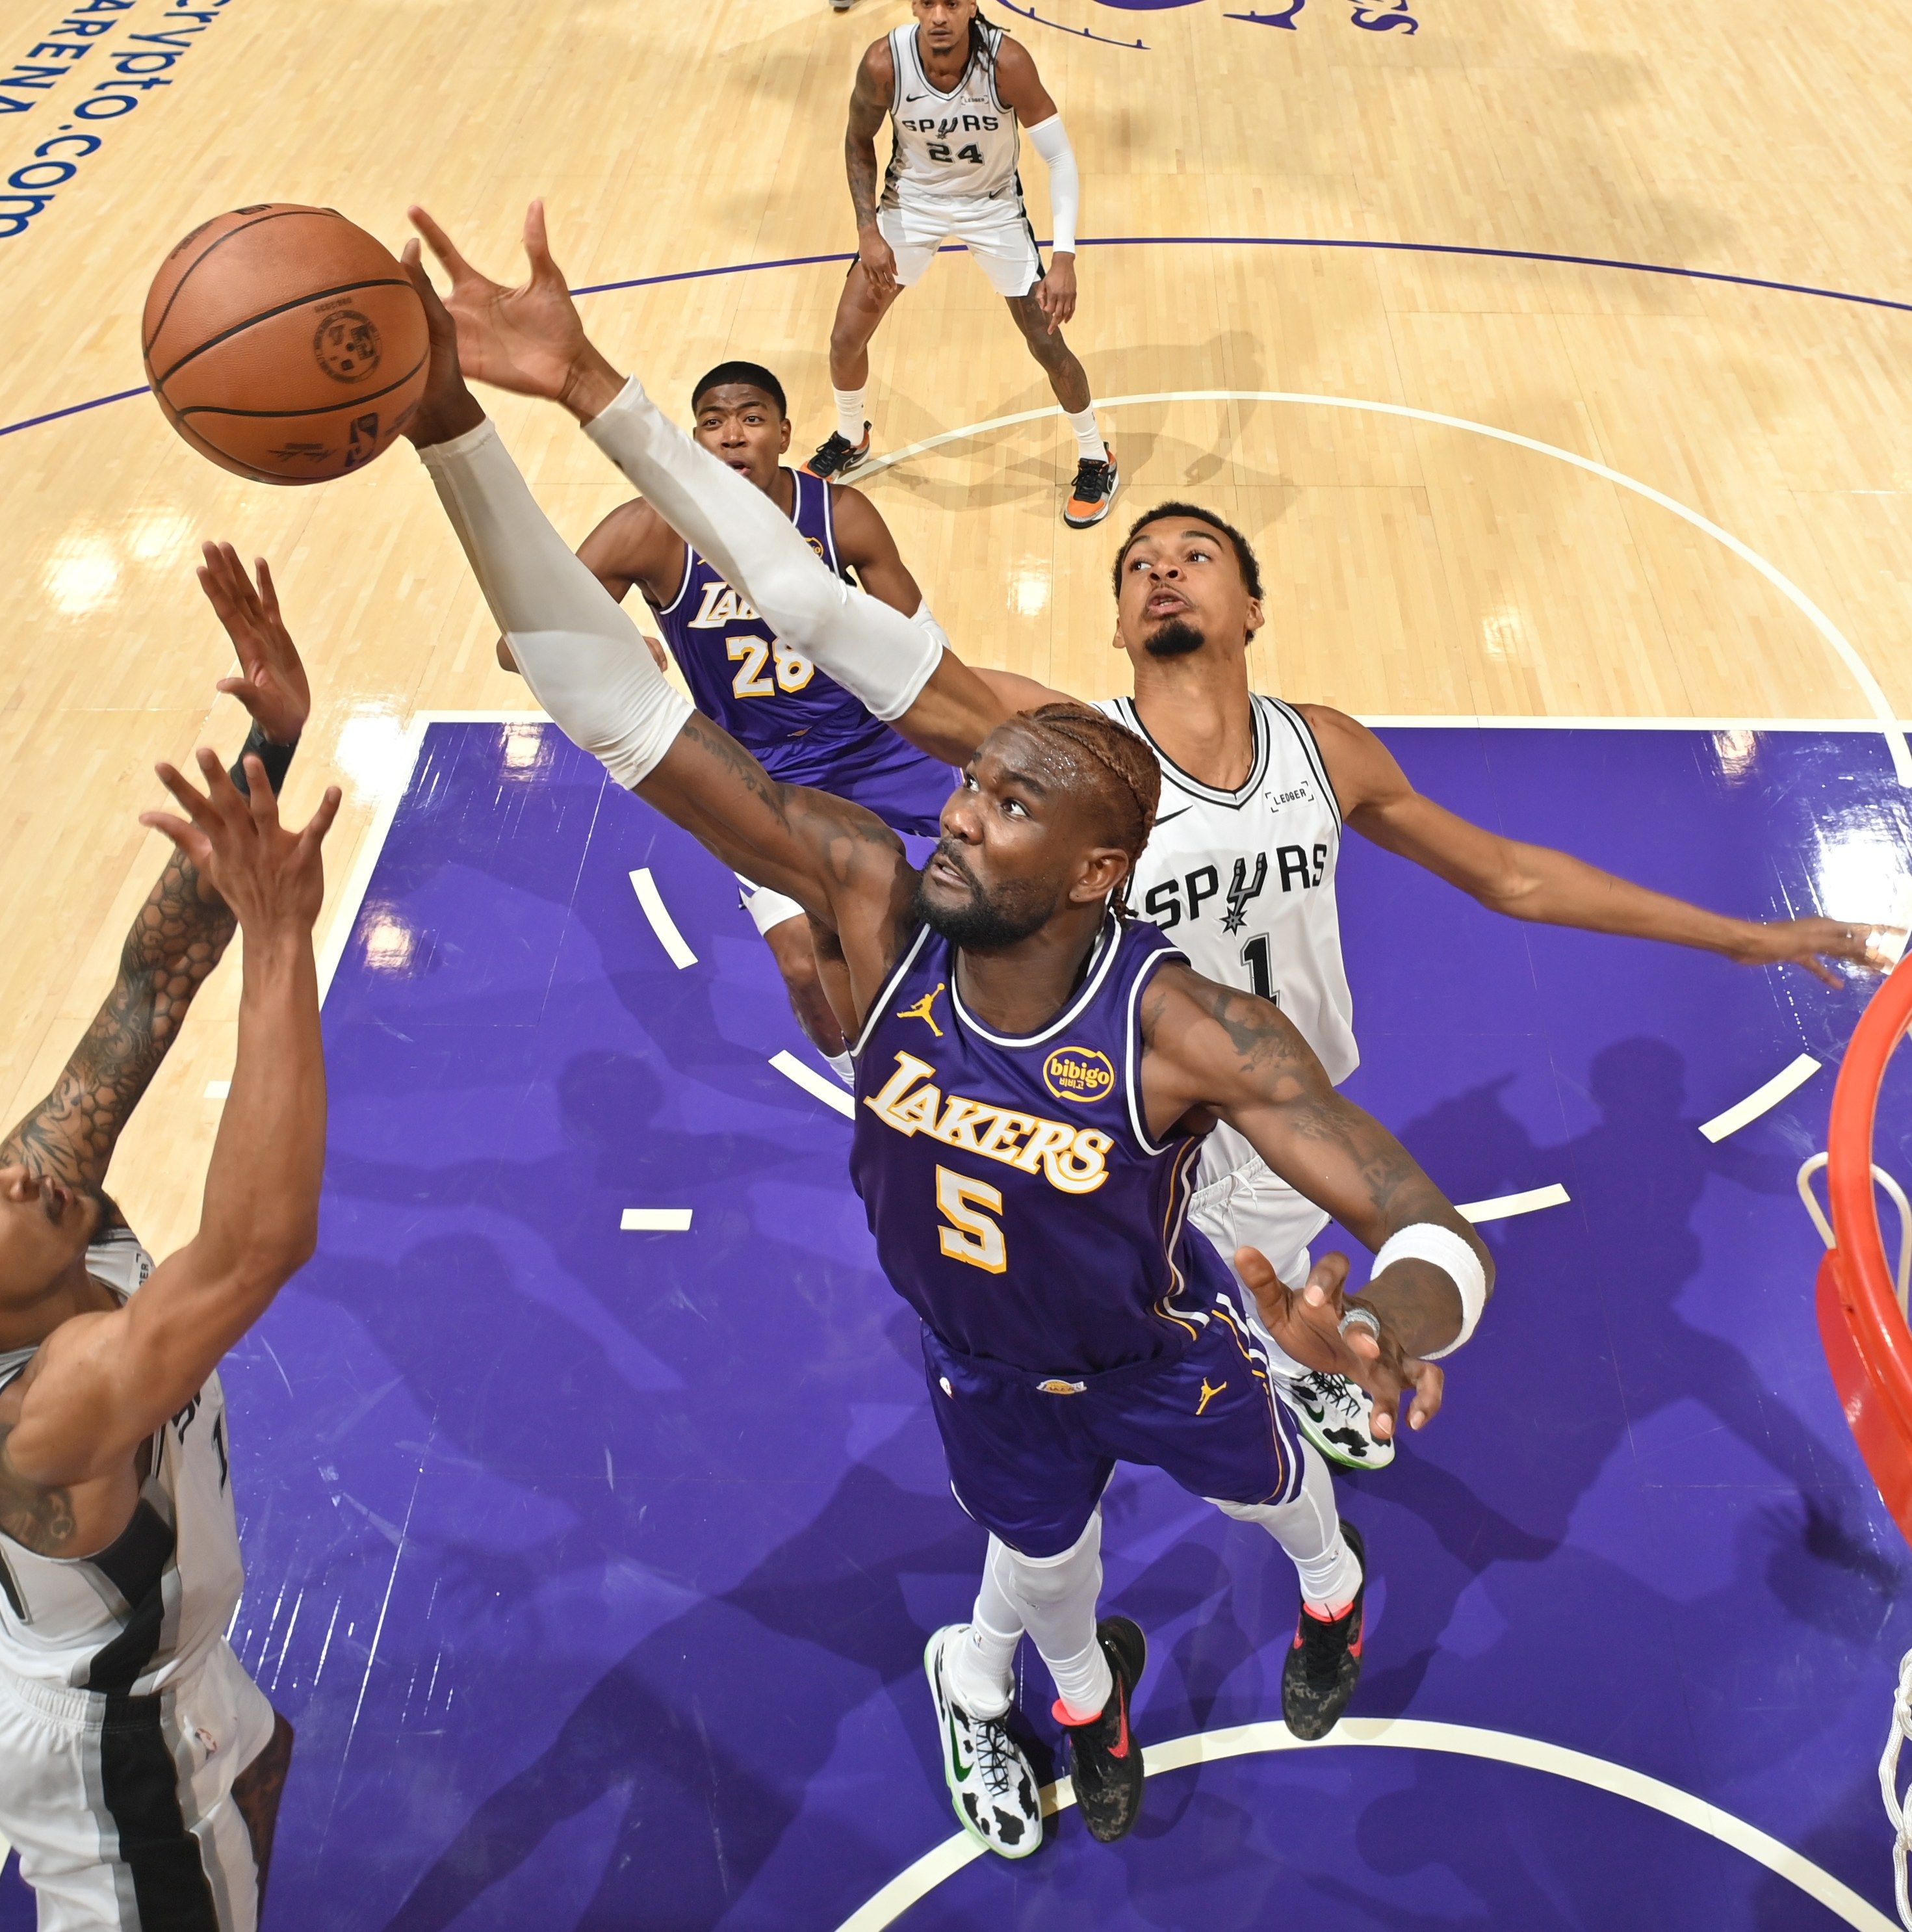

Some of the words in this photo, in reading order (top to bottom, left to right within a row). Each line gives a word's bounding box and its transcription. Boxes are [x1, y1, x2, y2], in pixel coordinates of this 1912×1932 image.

[901, 115, 999, 140] SPURS
[925, 141, 985, 166] 24
[725, 635, 814, 699] 28
[1273, 788, 1307, 805] LEDGER
[1145, 843, 1328, 937] SPURS
[1240, 932, 1281, 1008] 1
[1050, 1058, 1110, 1088] bibigo
[1059, 1077, 1085, 1090] 비비고
[863, 1050, 1115, 1194] LAKERS
[935, 1164, 1007, 1275] 5
